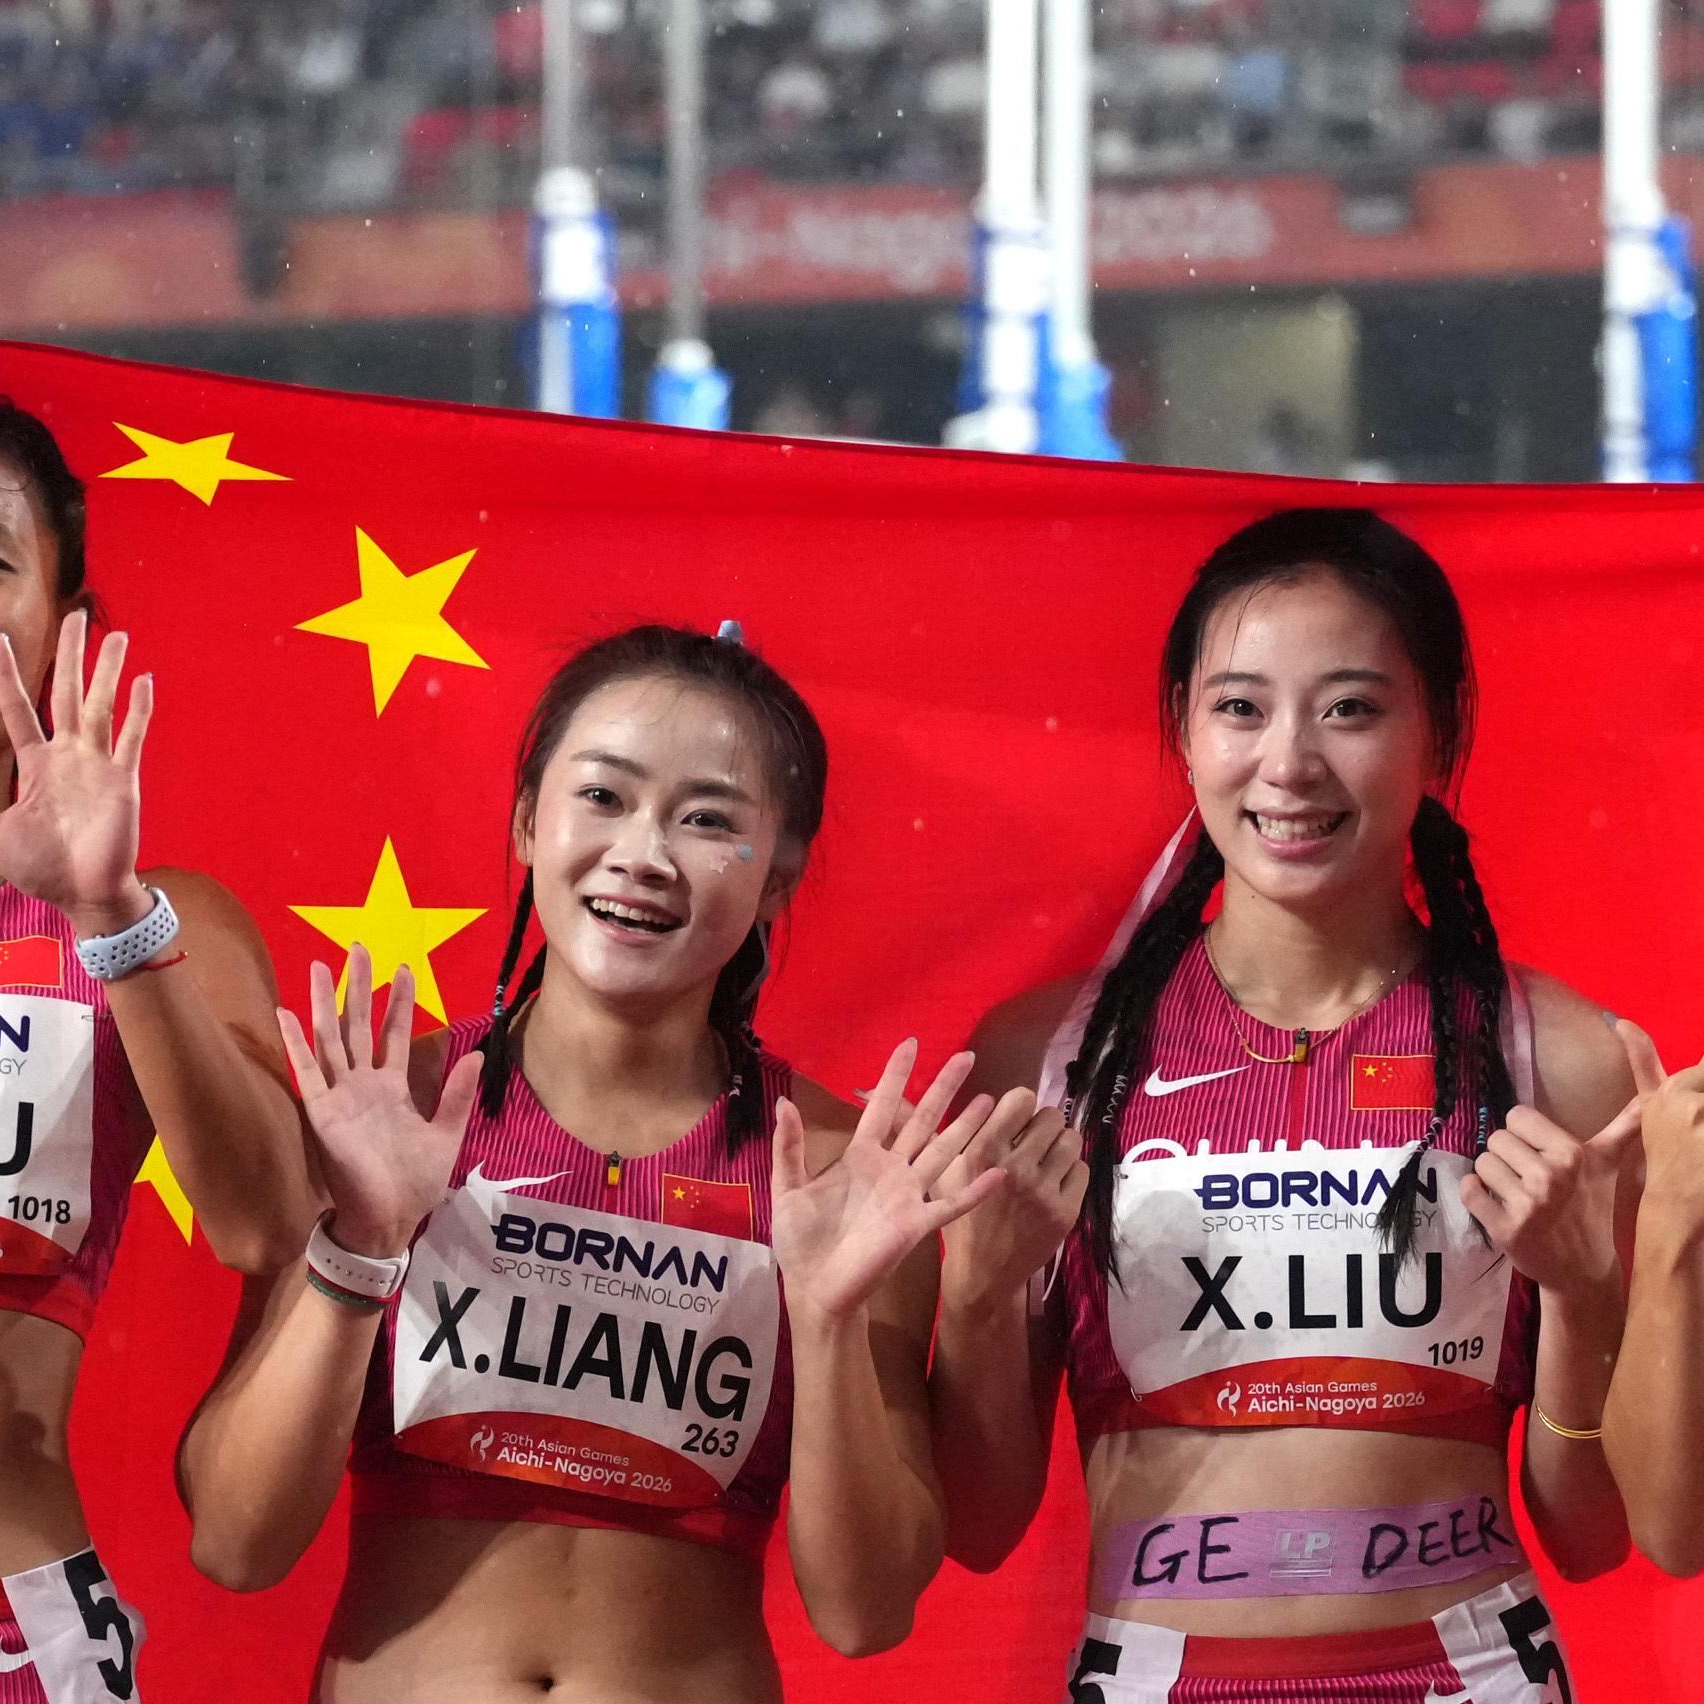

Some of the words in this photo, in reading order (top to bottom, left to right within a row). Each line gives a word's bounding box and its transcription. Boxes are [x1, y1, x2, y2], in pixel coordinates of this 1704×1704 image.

[7, 1195, 71, 1226] 1018
[1202, 1213, 1285, 1234] SPORTS
[1291, 1209, 1438, 1231] TECHNOGY
[491, 1213, 728, 1293] BORNAN
[490, 1256, 572, 1288] SPORTS
[581, 1272, 720, 1317] TECHNOLOGY
[1180, 1252, 1443, 1332] X.LIU
[419, 1280, 753, 1422] X.LIANG
[1427, 1336, 1484, 1367] 1019
[1247, 1382, 1281, 1395] 20th
[1284, 1381, 1324, 1394] Asian
[1327, 1380, 1378, 1393] Games
[1247, 1392, 1377, 1415] Aichi-Nagoya
[1382, 1391, 1426, 1408] 2026
[501, 1431, 534, 1449] 20th
[536, 1438, 576, 1456] Asian
[579, 1445, 630, 1467] Games
[681, 1423, 739, 1458] 263
[496, 1446, 626, 1486] Aichi-Nagoya
[631, 1471, 672, 1494] 2026
[1131, 1516, 1249, 1587] GE
[1361, 1497, 1515, 1579] DEER
[1278, 1531, 1331, 1559] LP
[62, 1550, 134, 1700] 5
